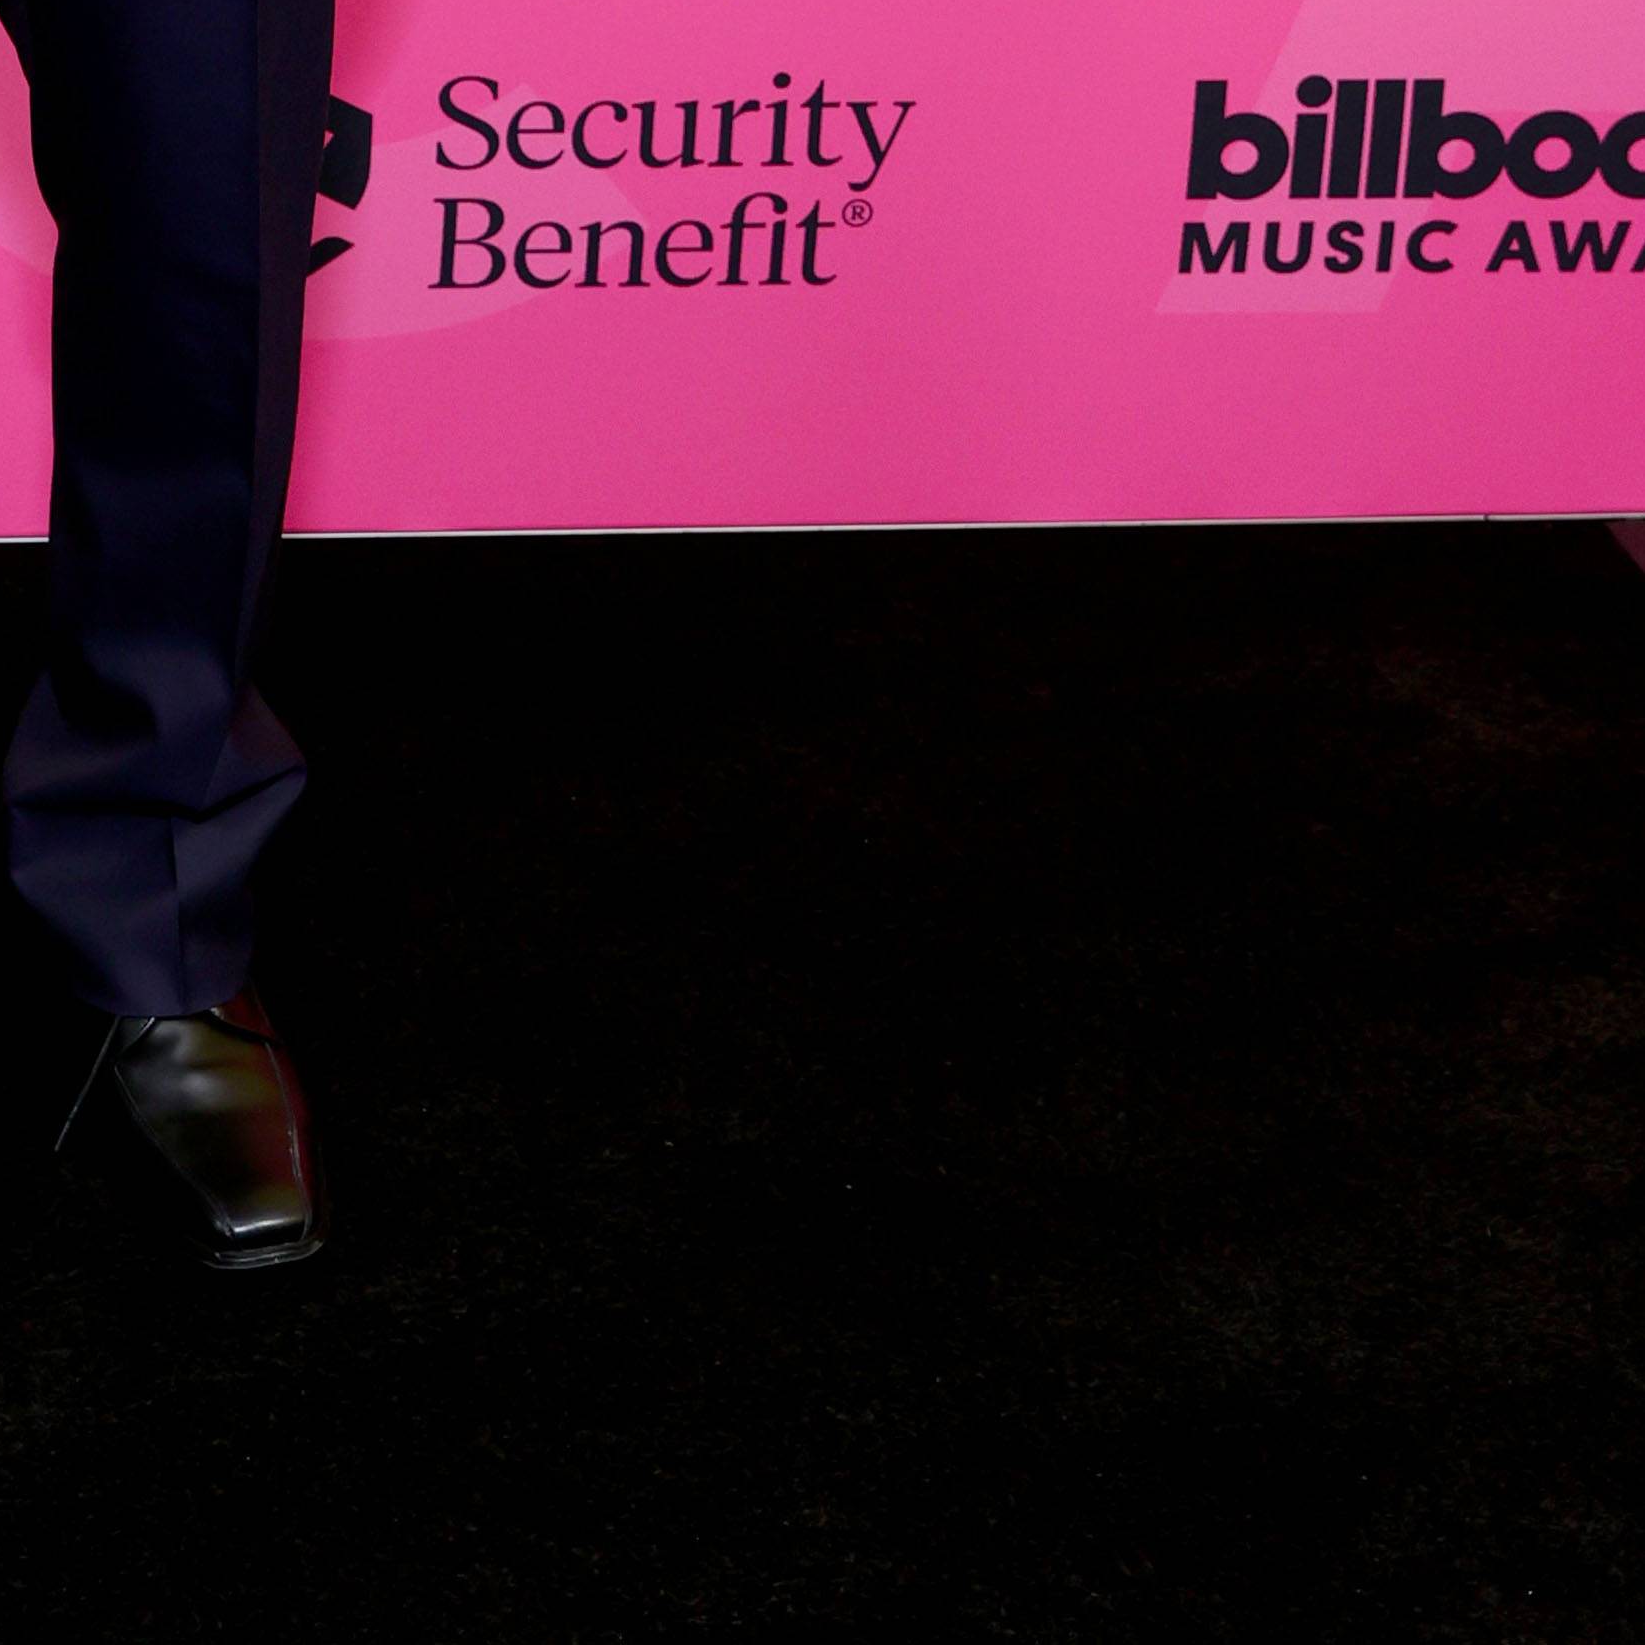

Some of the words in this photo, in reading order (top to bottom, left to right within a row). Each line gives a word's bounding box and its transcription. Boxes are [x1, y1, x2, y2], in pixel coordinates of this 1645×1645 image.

[437, 73, 916, 187] Security
[430, 190, 873, 289] Benefit®
[1180, 221, 1458, 274] MUSIC
[1487, 222, 1645, 273] AW
